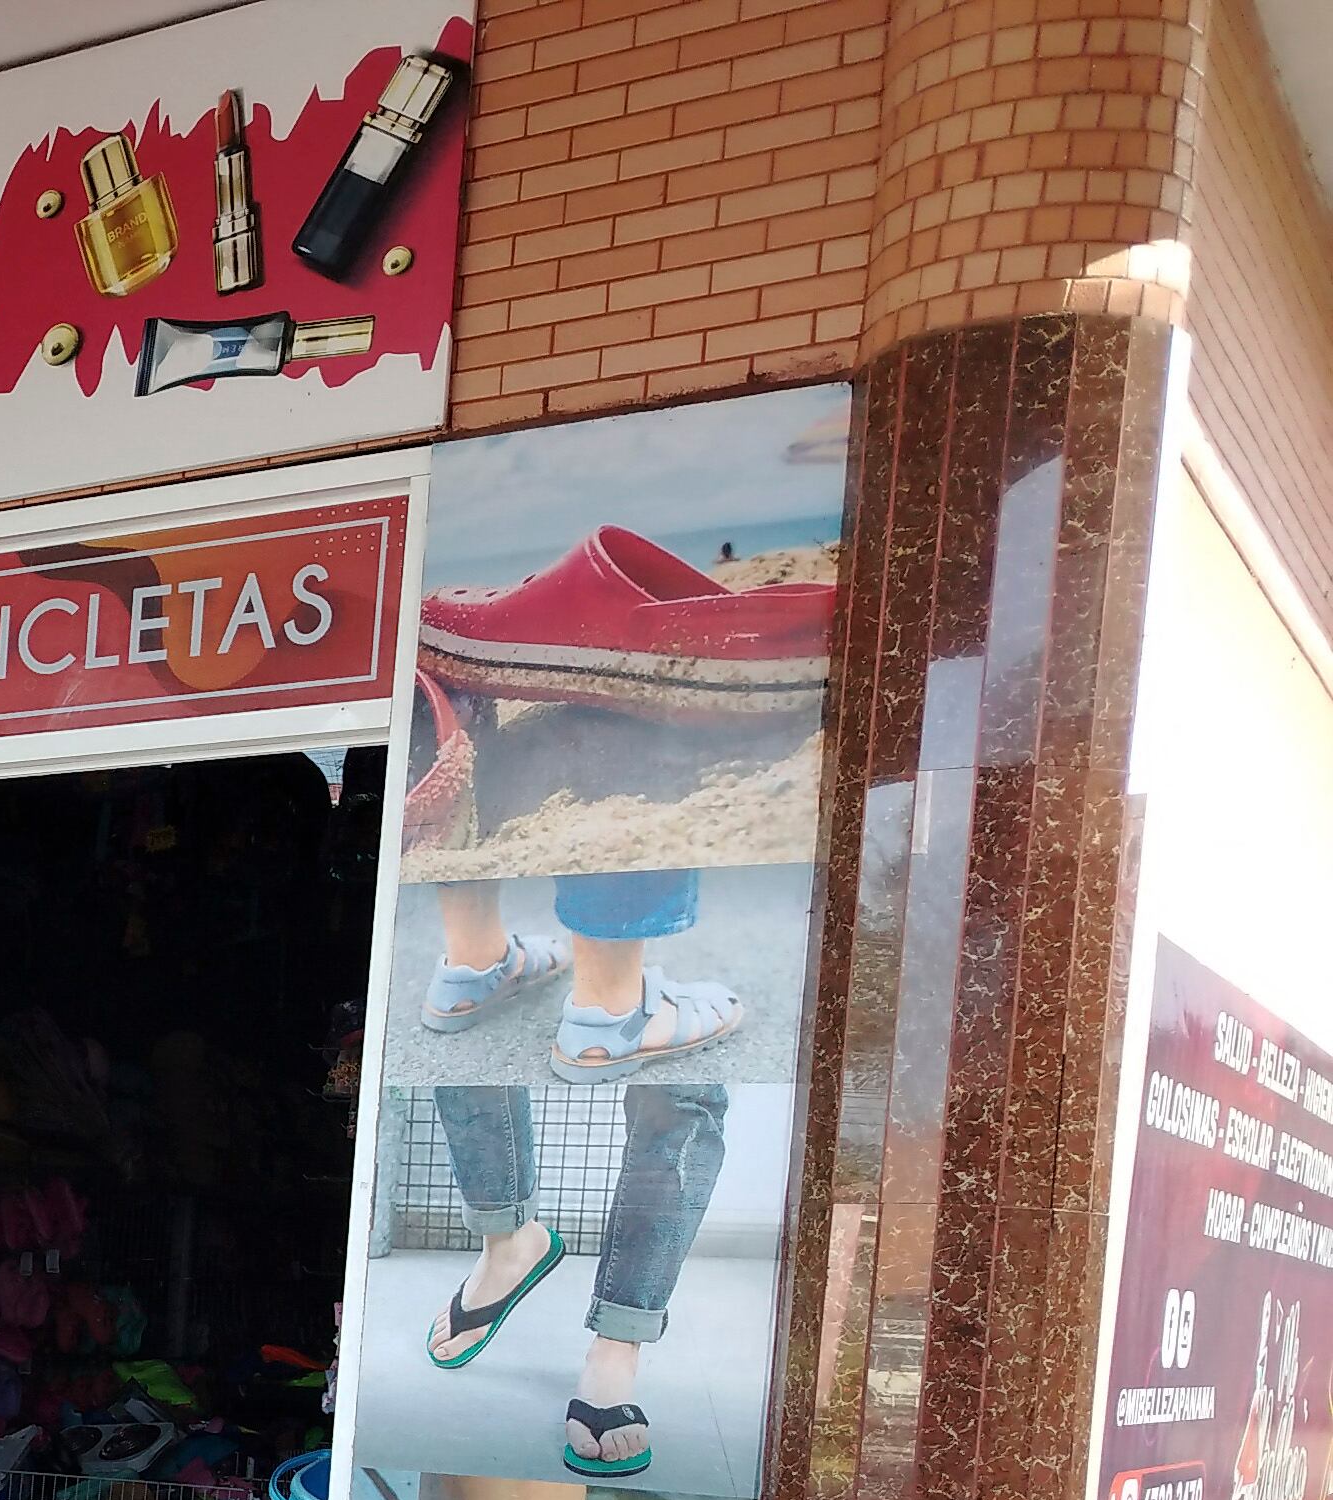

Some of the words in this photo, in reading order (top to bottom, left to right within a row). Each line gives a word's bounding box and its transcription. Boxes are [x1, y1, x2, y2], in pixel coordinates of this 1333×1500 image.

[107, 211, 148, 243] BRAND
[1214, 1011, 1253, 1075] SALUD
[1257, 1038, 1301, 1103] BELLEZA
[1146, 1070, 1220, 1149] GOLOSINAS
[1224, 1107, 1274, 1171] ESCOLAR
[1204, 1188, 1245, 1244] HOGAR
[1310, 1222, 1320, 1262] Y
[1117, 1386, 1216, 1427] @MIBELLEZAPANAMA
